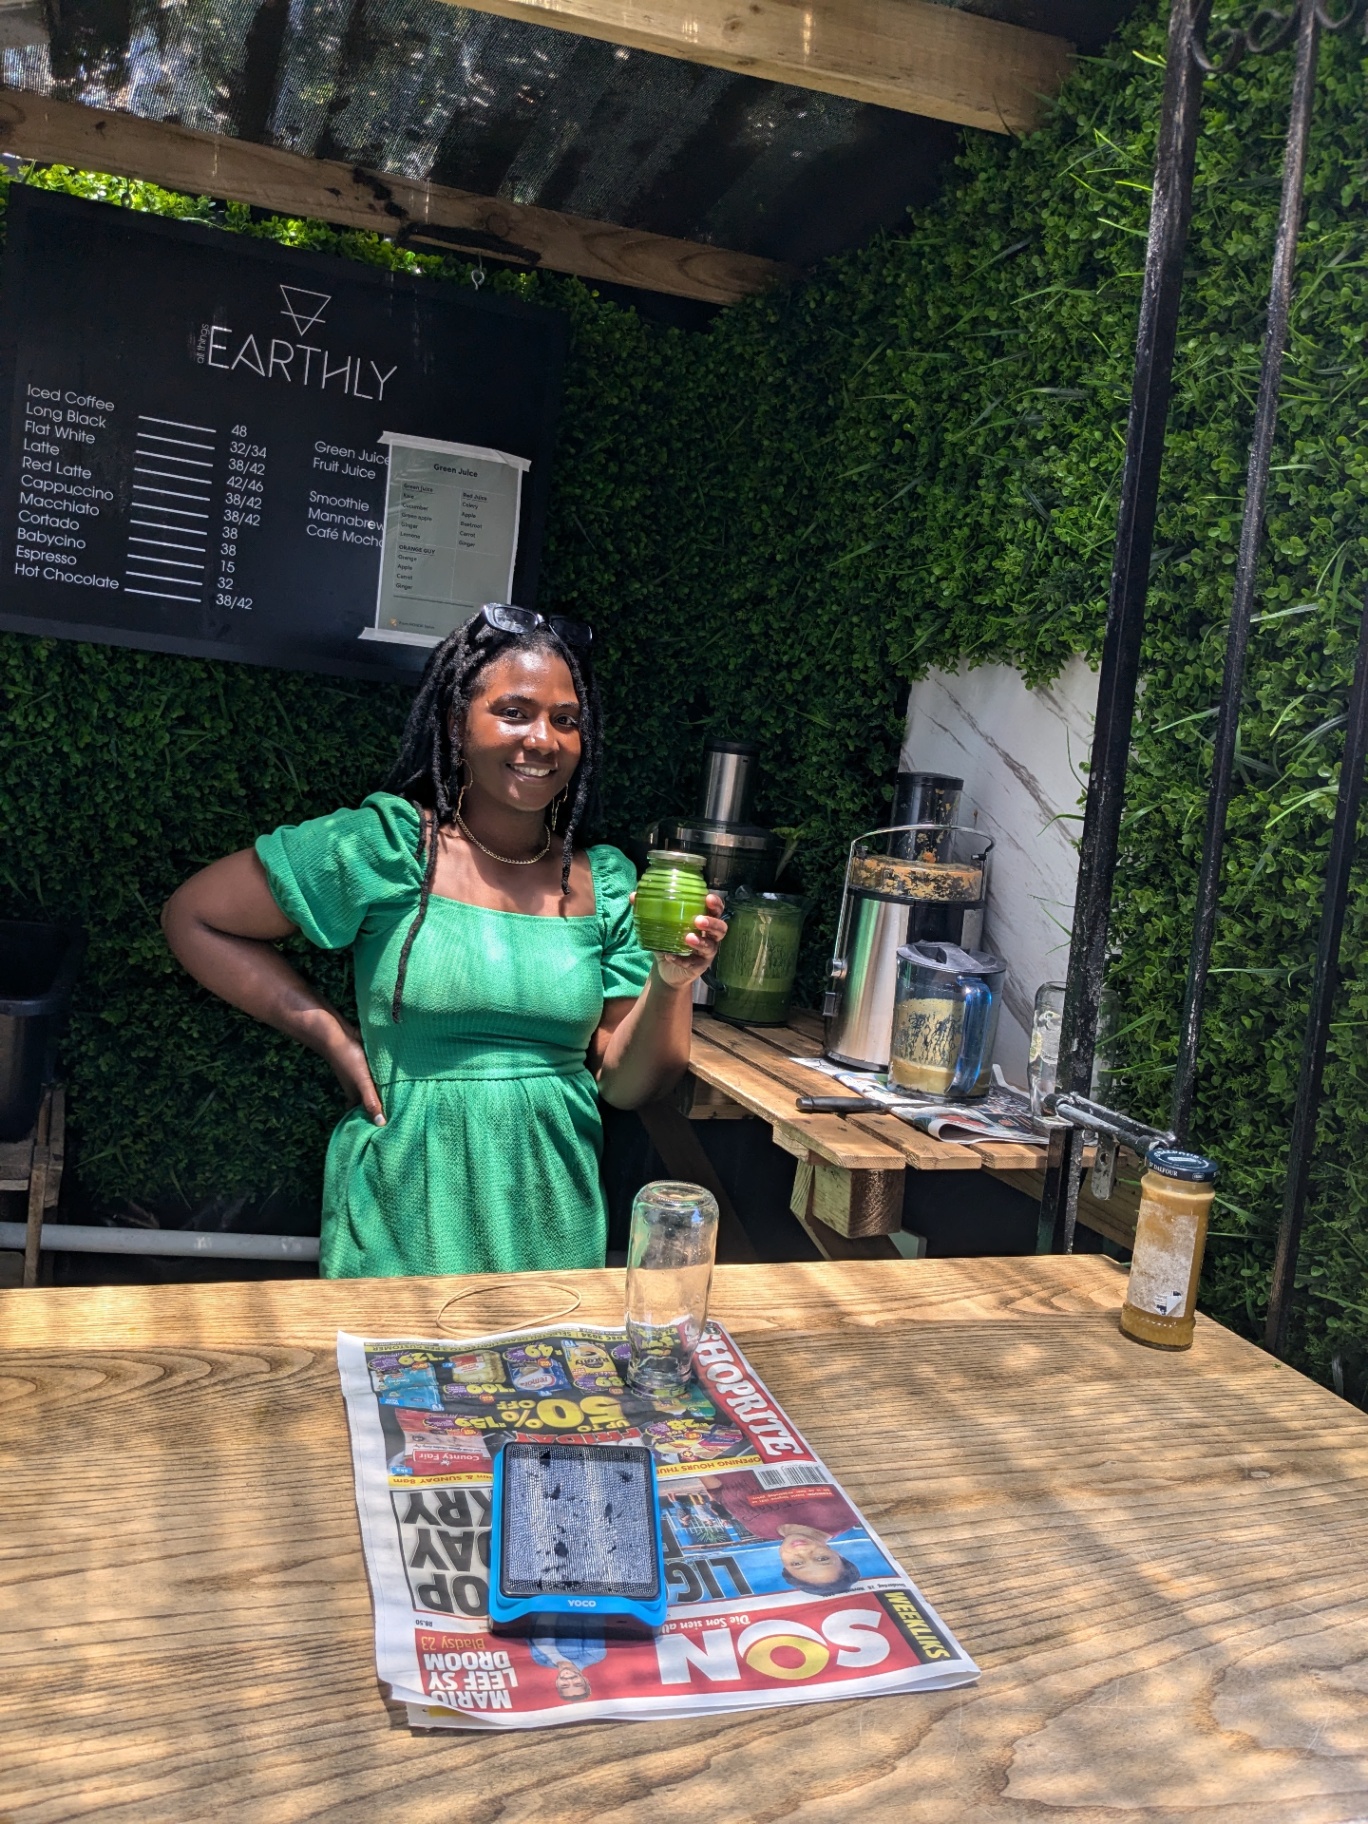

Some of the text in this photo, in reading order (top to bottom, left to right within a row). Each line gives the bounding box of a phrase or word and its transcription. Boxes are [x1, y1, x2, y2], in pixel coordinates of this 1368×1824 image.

[208, 325, 397, 401] EARTHLY
[27, 384, 115, 411] Iced Coffee
[26, 402, 107, 428] Long Black
[25, 420, 96, 444] Flat White
[231, 424, 247, 437] 48
[23, 438, 59, 455] Latte
[229, 441, 267, 459] 32/34
[314, 440, 390, 466] Green Juice
[22, 456, 92, 479] Red Latte
[228, 458, 265, 475] 38/42
[313, 457, 376, 480] Fruit Juice
[433, 463, 478, 478] Green Juice
[21, 474, 114, 501] Cappuccino
[226, 476, 264, 492] 42/46
[20, 491, 100, 516] Macchiato
[225, 492, 262, 509] 38/42
[309, 490, 370, 512] Smoothie
[18, 510, 80, 530] Cortado
[223, 509, 260, 526] 38/42
[17, 527, 86, 549] Babycino
[222, 526, 238, 539] 38
[306, 524, 339, 540] Café
[16, 545, 77, 565] Espresso
[220, 543, 236, 556] 38
[221, 560, 235, 573] 15
[15, 562, 119, 589] Hot Chocolate
[217, 576, 234, 590] 32
[215, 593, 253, 610] 38/42
[1153, 1164, 1178, 1177] DALFOUR
[497, 1400, 537, 1410] OFF
[577, 1420, 630, 1433] UP TO
[442, 1452, 480, 1461] County
[657, 1456, 761, 1474] OPENING HOURS THU
[420, 1475, 462, 1484] SUNDAY
[664, 1557, 754, 1602] LIG
[567, 1600, 597, 1608] YOCO
[680, 1619, 703, 1631] sien
[705, 1617, 728, 1628] Son
[729, 1614, 751, 1625] Die
[884, 1591, 951, 1659] WEEKLIKS
[421, 1635, 486, 1650] Bladsy 23
[655, 1609, 891, 1685] SON
[423, 1651, 512, 1671] DROOM
[428, 1667, 519, 1690] LEEF SY
